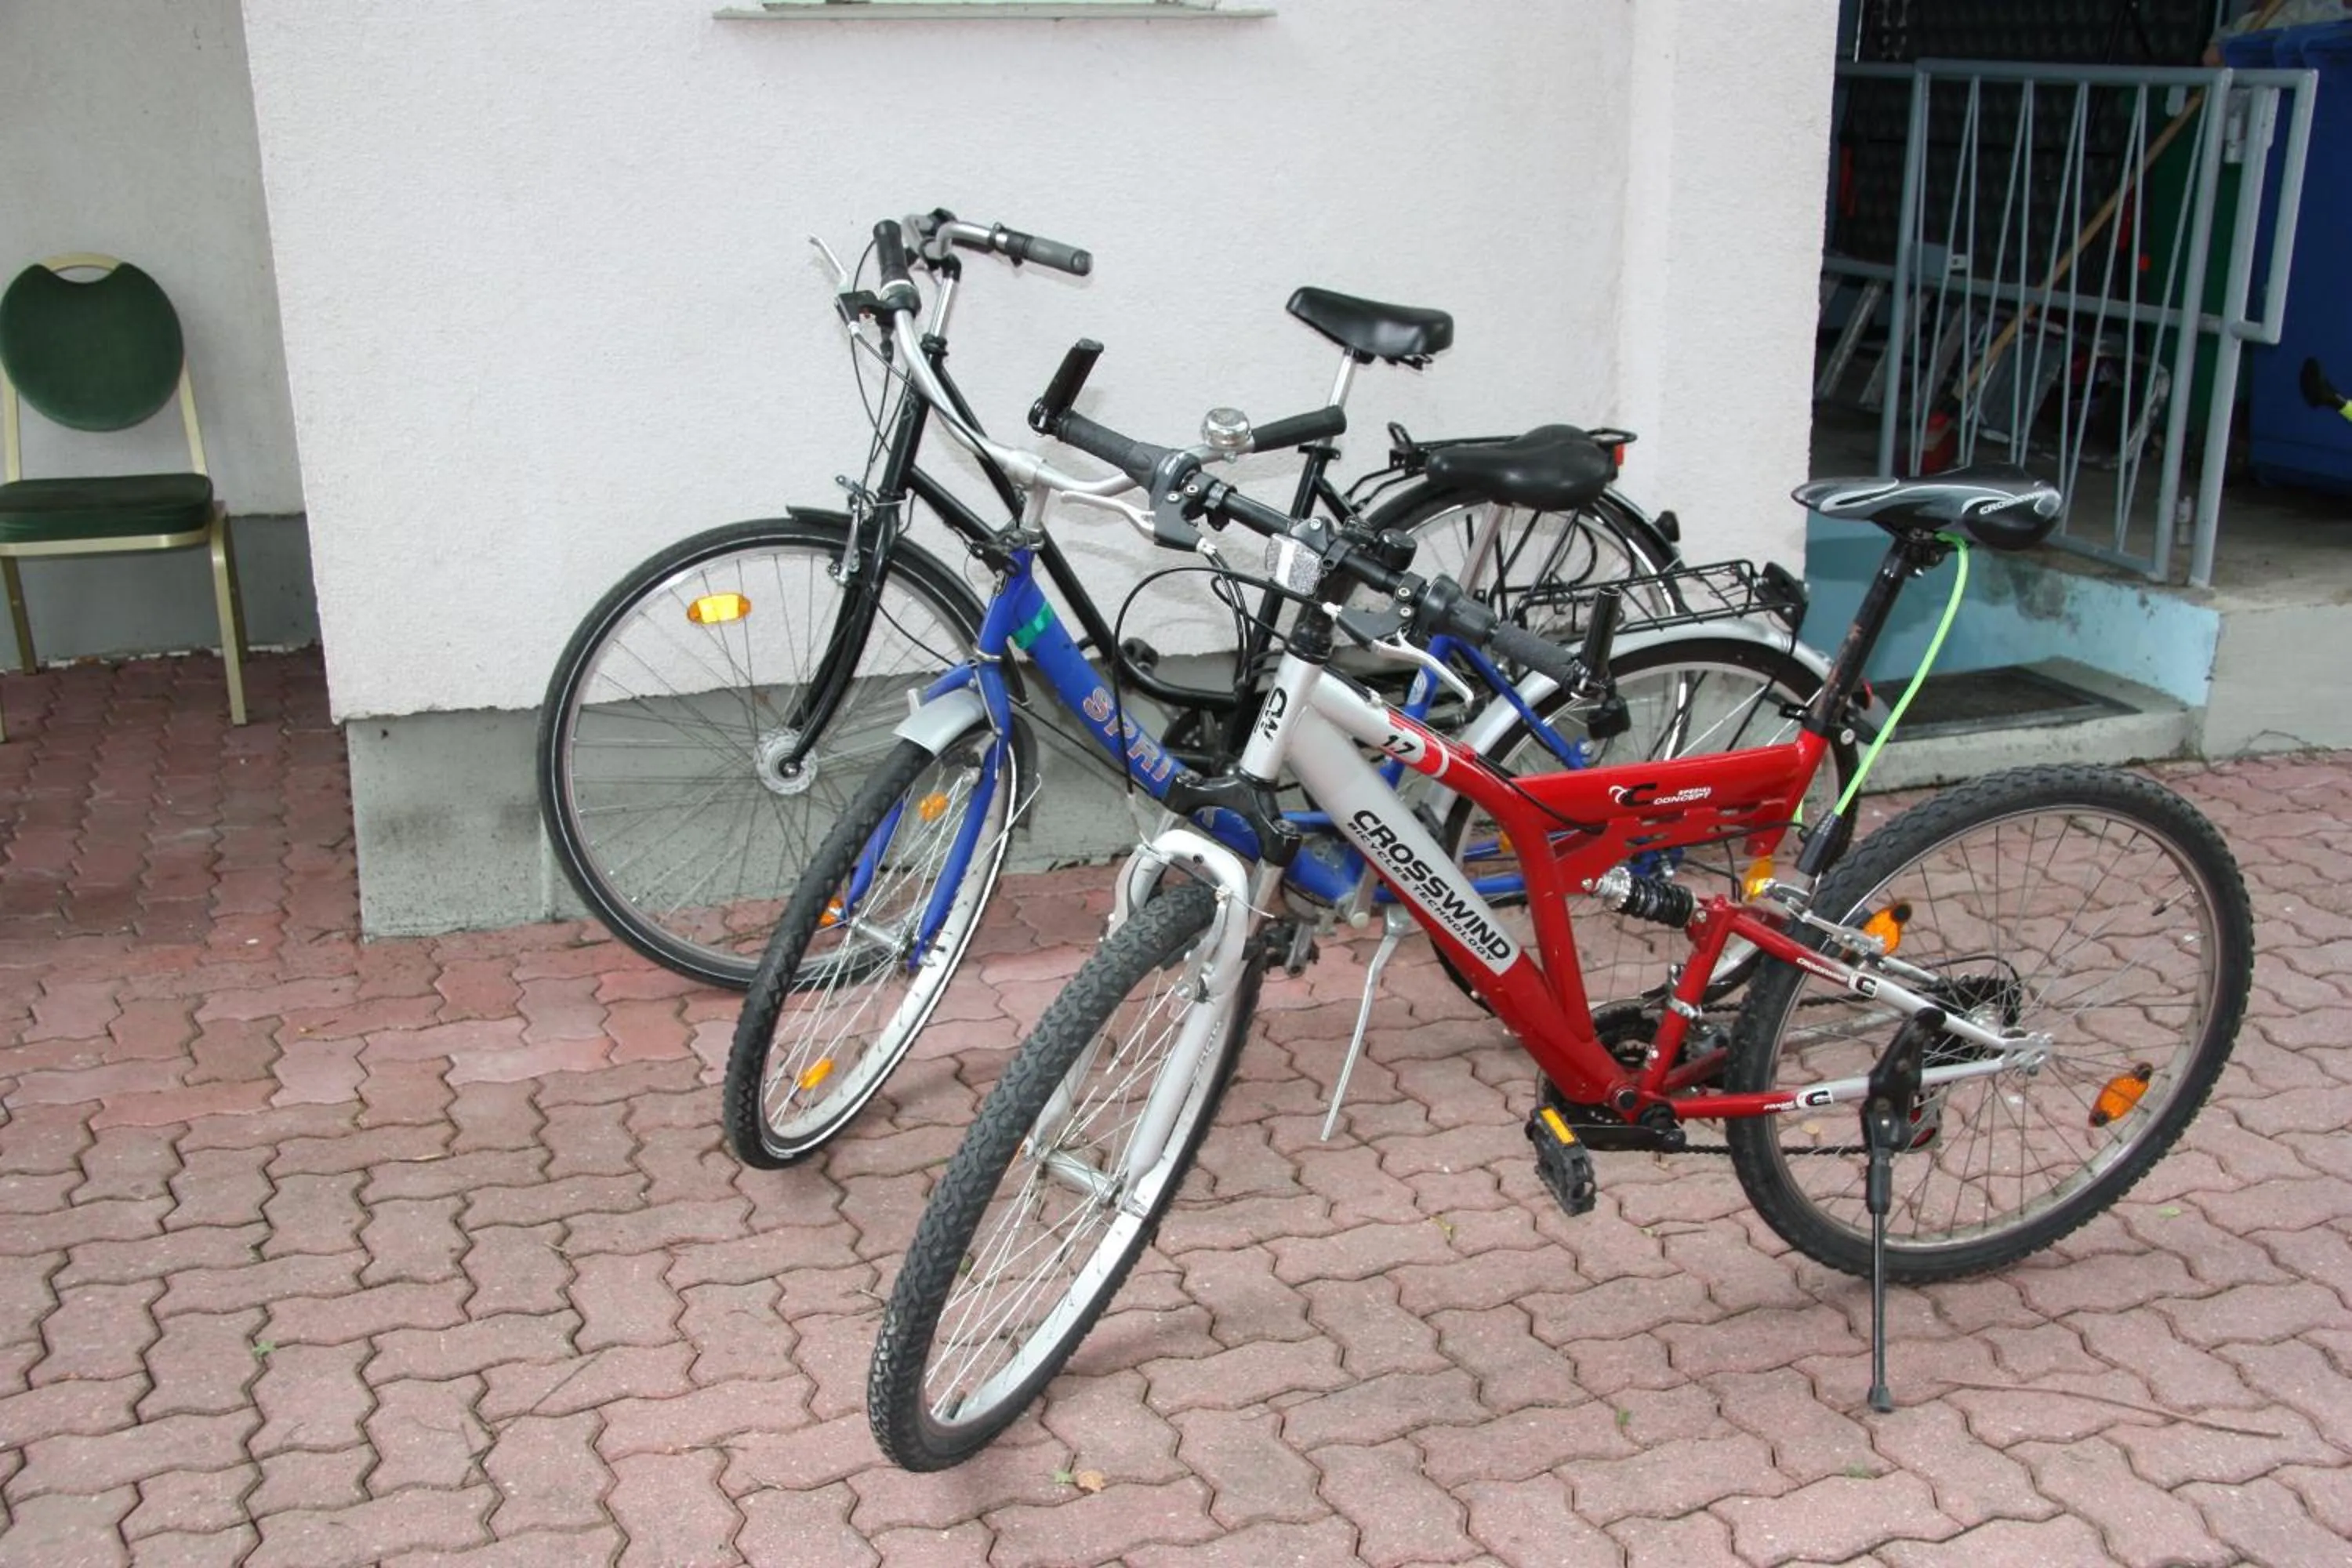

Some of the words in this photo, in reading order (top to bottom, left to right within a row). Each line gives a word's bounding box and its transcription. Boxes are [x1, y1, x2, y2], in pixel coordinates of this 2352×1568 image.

[1347, 822, 1411, 882] BICYCLES
[1413, 884, 1495, 961] TECHNOLOGY
[1353, 810, 1512, 959] CROSSWIND
